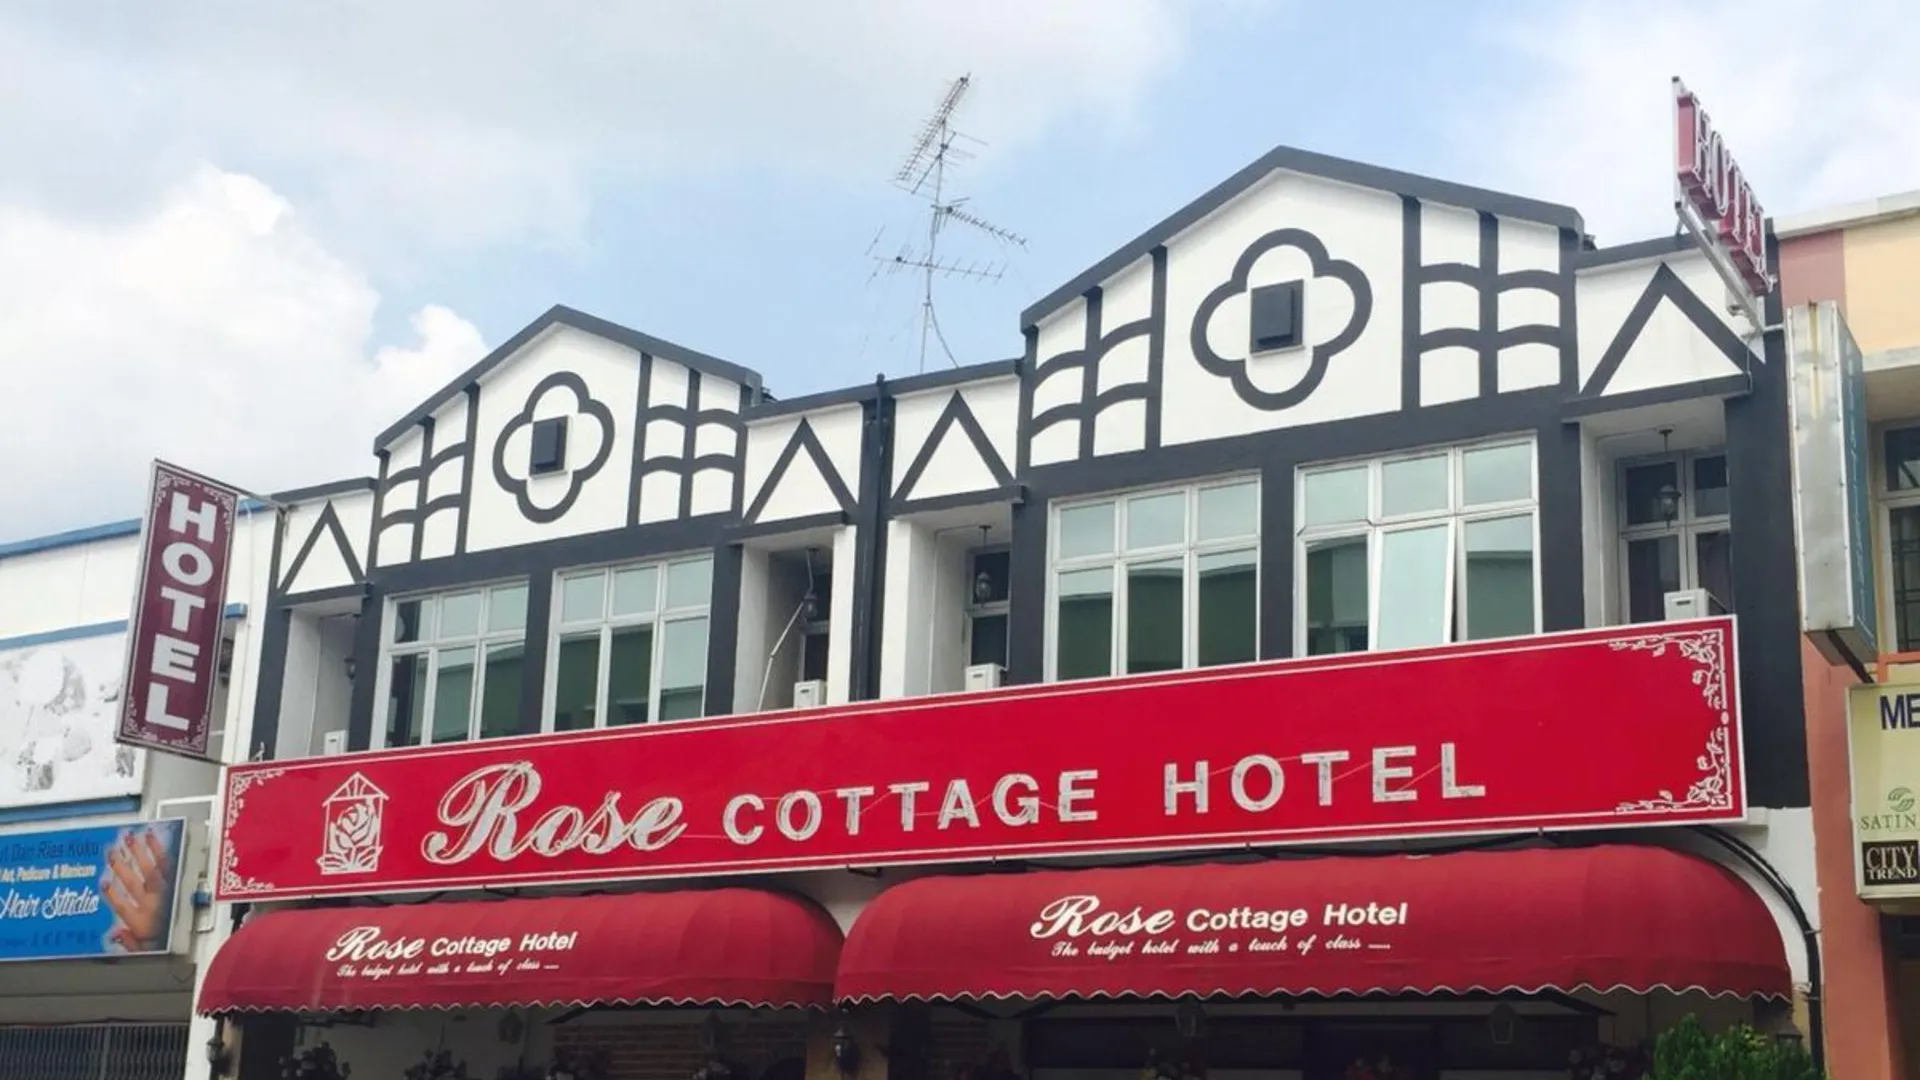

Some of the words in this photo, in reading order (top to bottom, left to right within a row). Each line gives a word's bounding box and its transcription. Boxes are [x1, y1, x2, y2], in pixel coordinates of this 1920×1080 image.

[145, 491, 217, 731] HOTEL
[421, 760, 687, 864] Rose
[723, 769, 1099, 845] COTTAGE
[1163, 742, 1486, 816] HOTEL
[1861, 814, 1916, 831] SATIN
[1866, 846, 1915, 870] CITY
[1867, 867, 1917, 880] TREND
[0, 888, 40, 919] Hair
[42, 886, 99, 919] Studio
[1030, 895, 1176, 938] Rose
[1186, 907, 1308, 934] Cottage
[1323, 902, 1408, 926] Hotel
[326, 926, 425, 961] Rose
[431, 937, 511, 957] Cottage
[519, 931, 578, 951] Hotel
[1051, 941, 1079, 957] The
[1087, 940, 1135, 960] budget
[1141, 939, 1180, 954] hotel
[1187, 939, 1219, 954] with
[1228, 943, 1239, 952] a
[1248, 936, 1288, 951] touch
[1297, 934, 1317, 955] of
[1325, 934, 1362, 949] class
